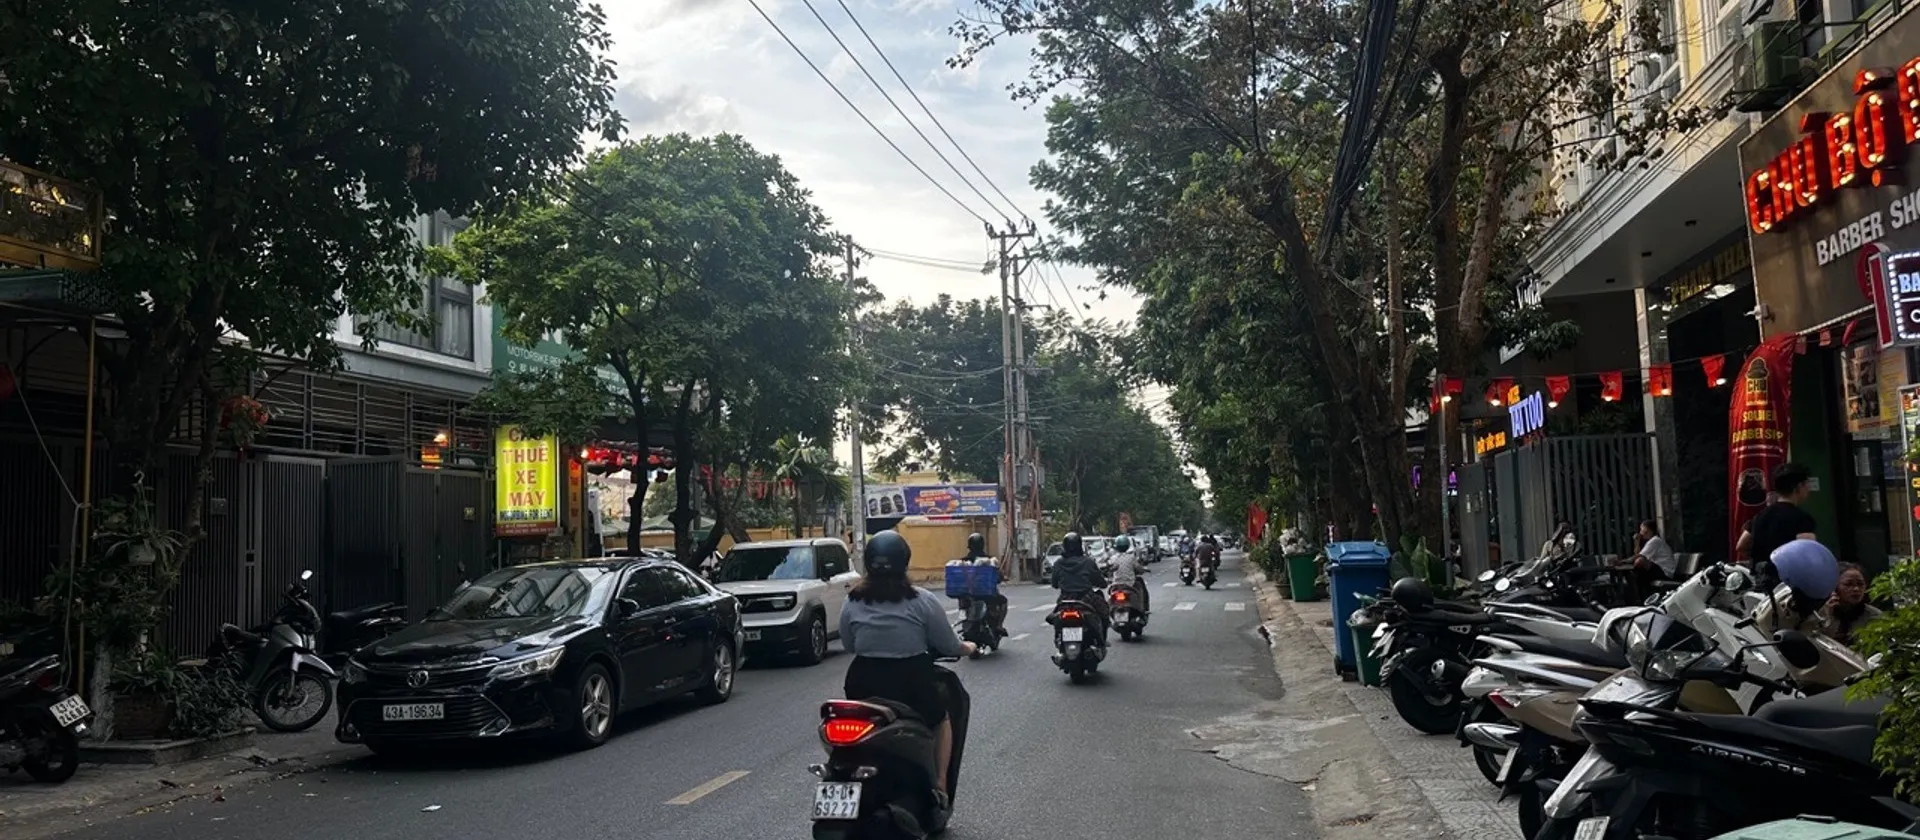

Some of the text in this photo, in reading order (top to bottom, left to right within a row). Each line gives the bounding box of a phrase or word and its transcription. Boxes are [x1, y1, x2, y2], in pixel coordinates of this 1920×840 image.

[1816, 211, 1885, 266] BARBER
[1508, 390, 1544, 438] TATTOO
[502, 441, 549, 464] THUÊ
[515, 469, 537, 485] XE
[508, 487, 545, 507] MÁY
